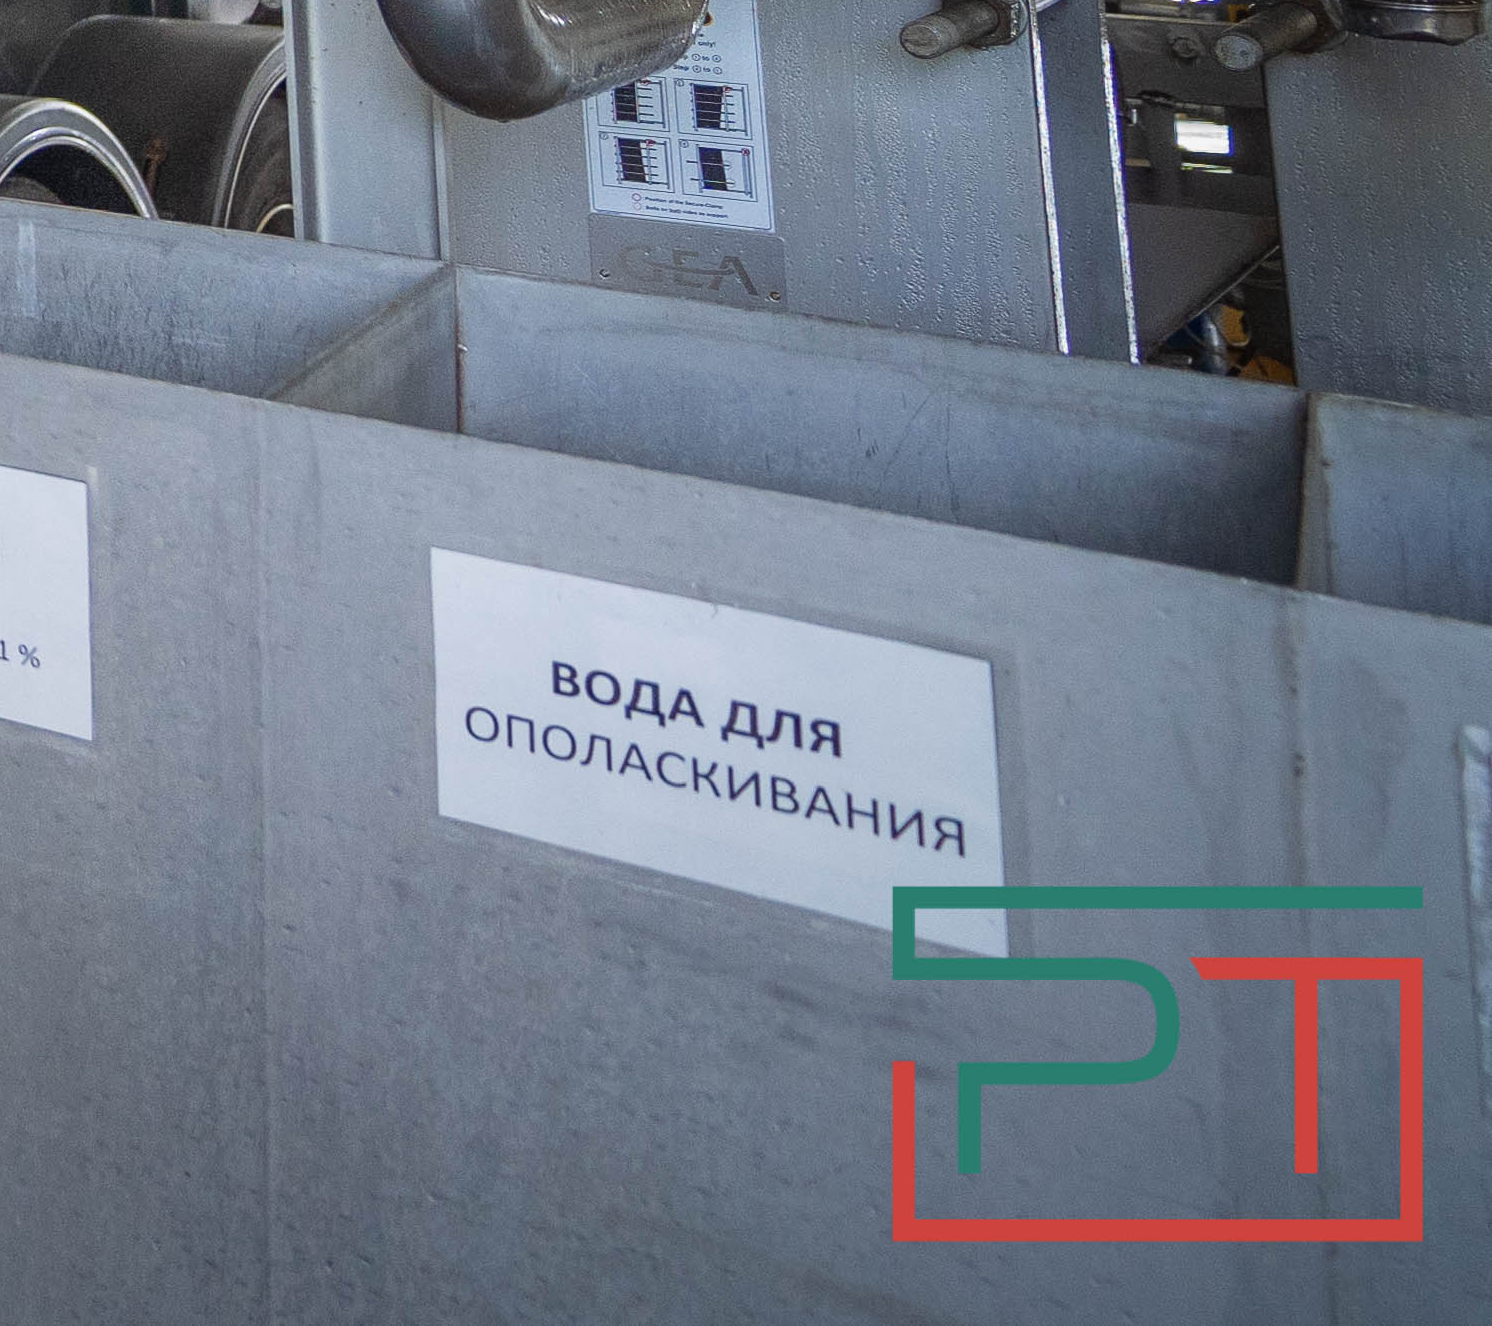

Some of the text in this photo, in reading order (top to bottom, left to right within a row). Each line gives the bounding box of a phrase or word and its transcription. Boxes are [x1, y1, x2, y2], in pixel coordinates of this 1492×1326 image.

[18, 645, 41, 669] %
[551, 660, 843, 759] ВОДА ДЛЯ
[465, 706, 966, 859] ОПОЛАСКИВАНИЯ
